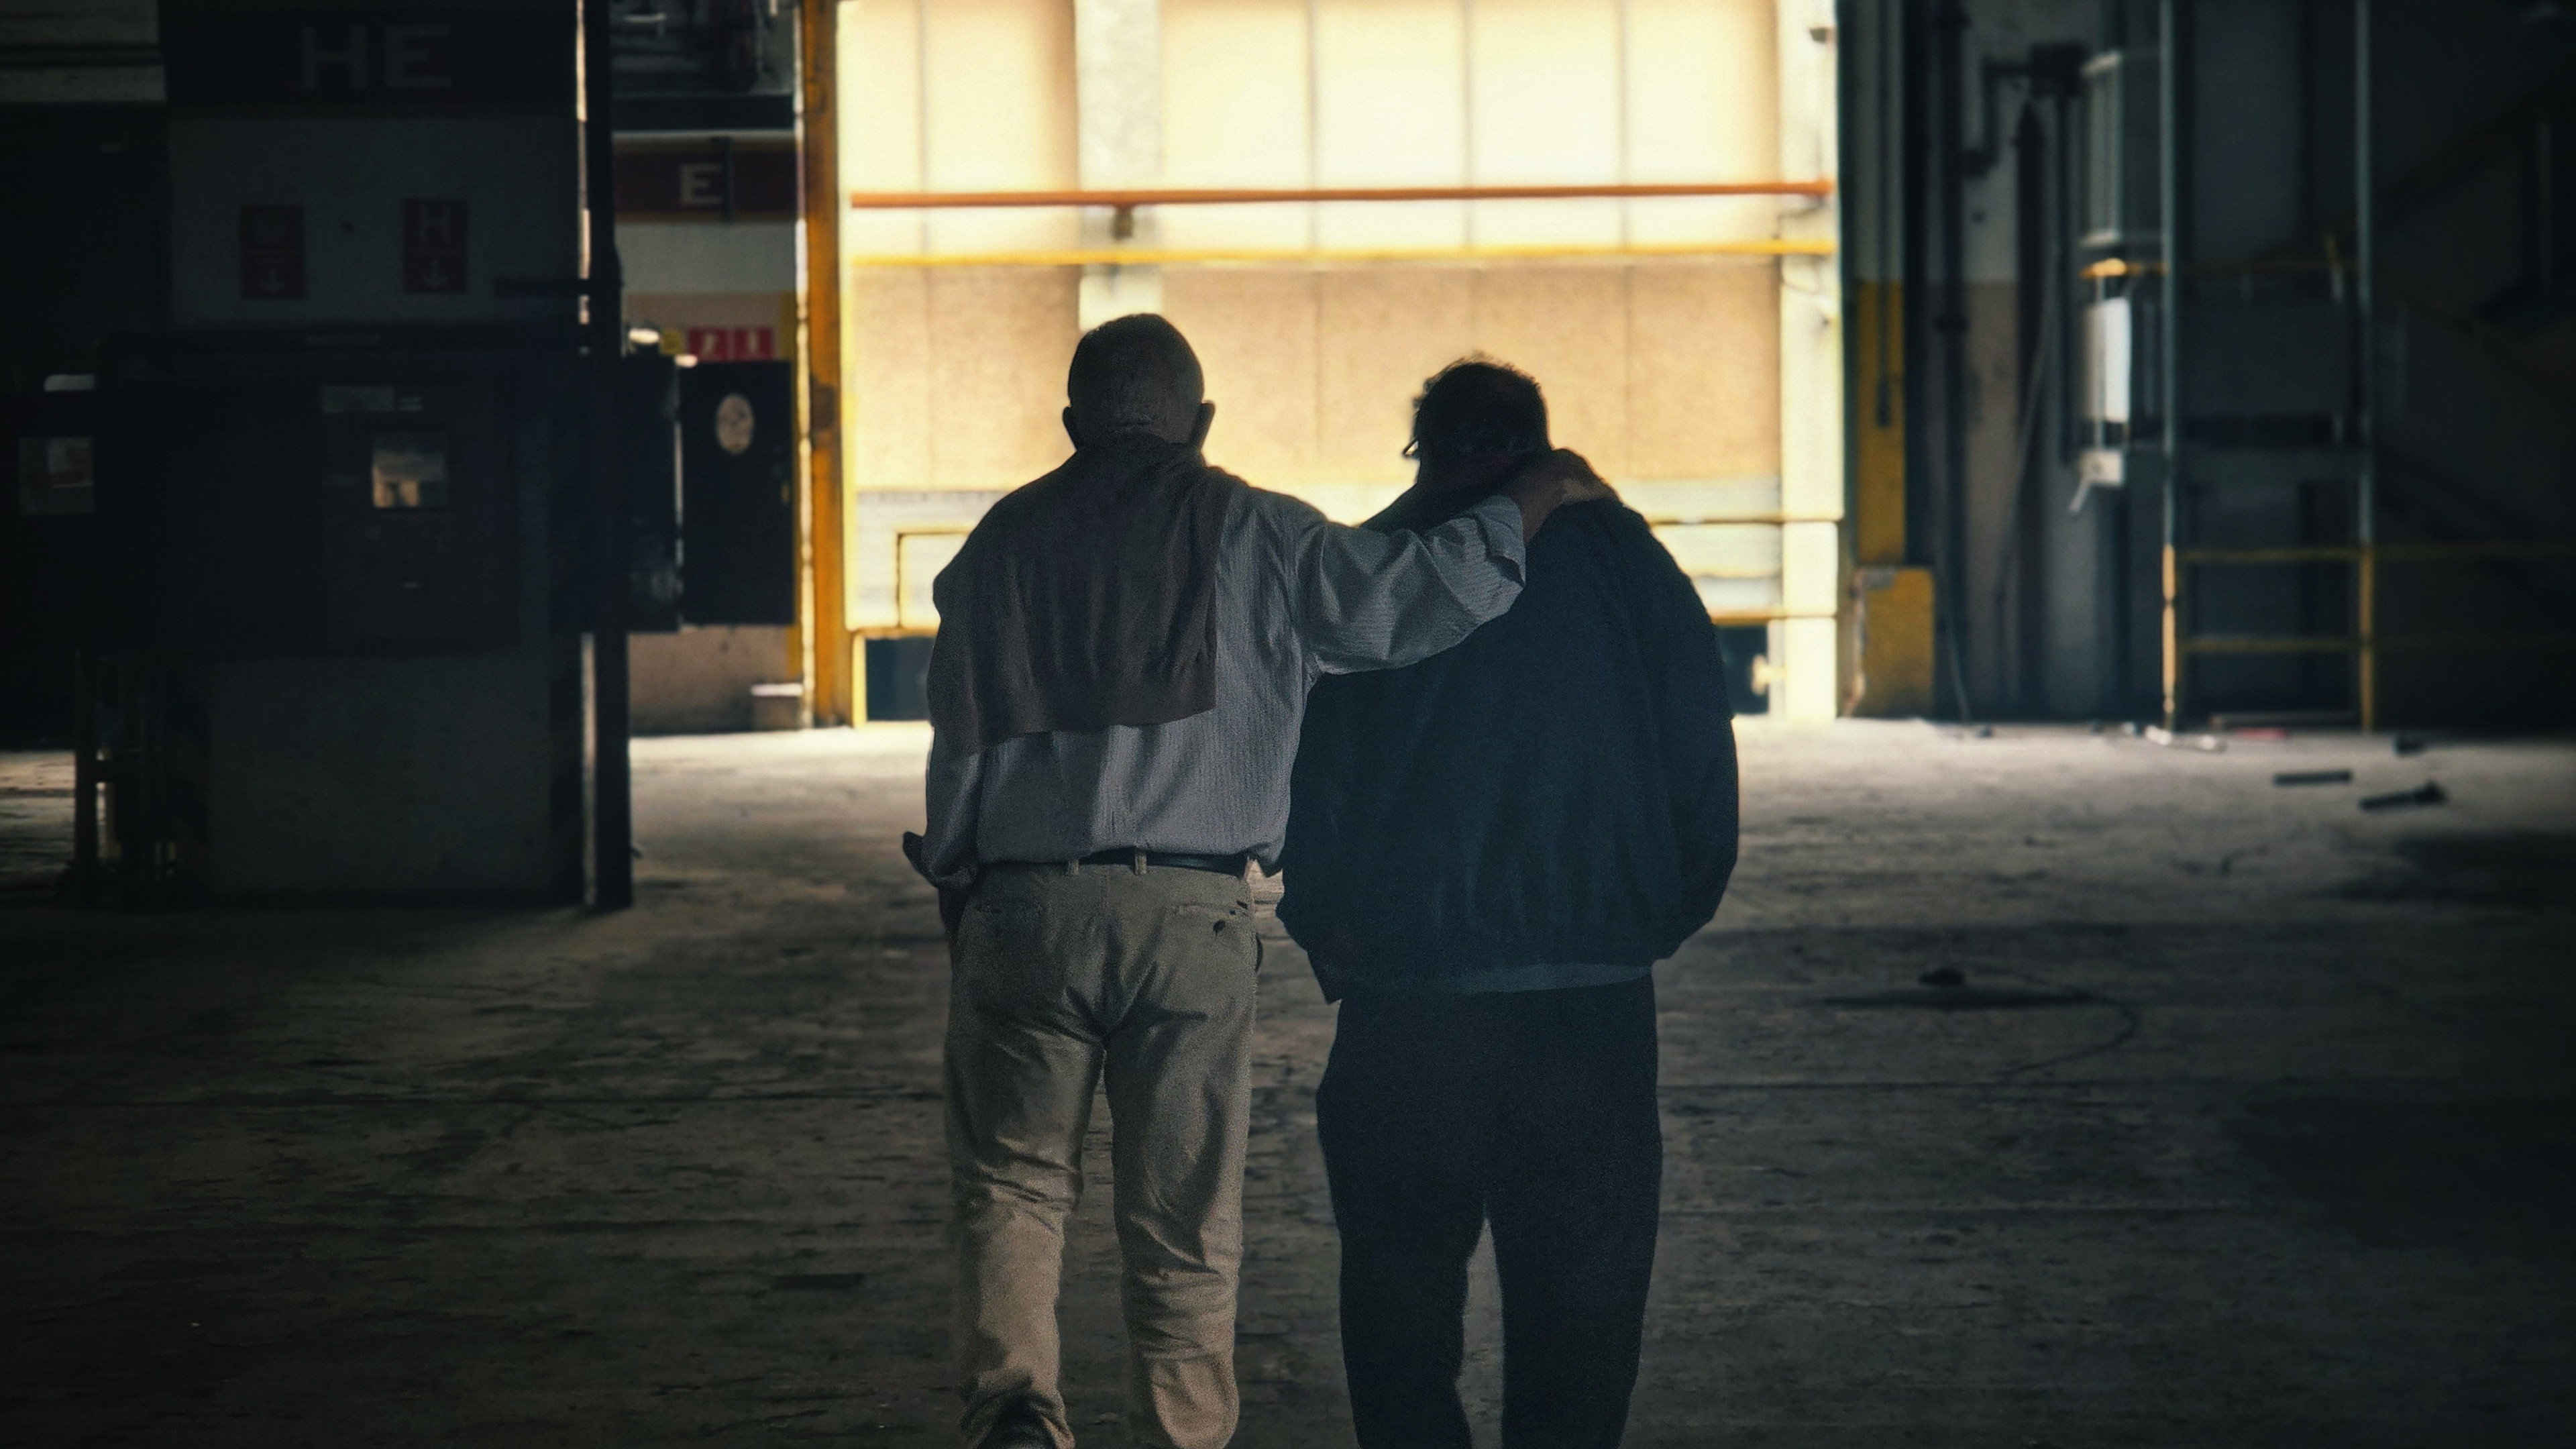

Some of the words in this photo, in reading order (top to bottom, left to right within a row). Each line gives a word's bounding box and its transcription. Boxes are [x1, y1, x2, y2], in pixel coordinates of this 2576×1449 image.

[301, 25, 451, 90] HE
[680, 163, 723, 205] E
[419, 202, 451, 243] H
